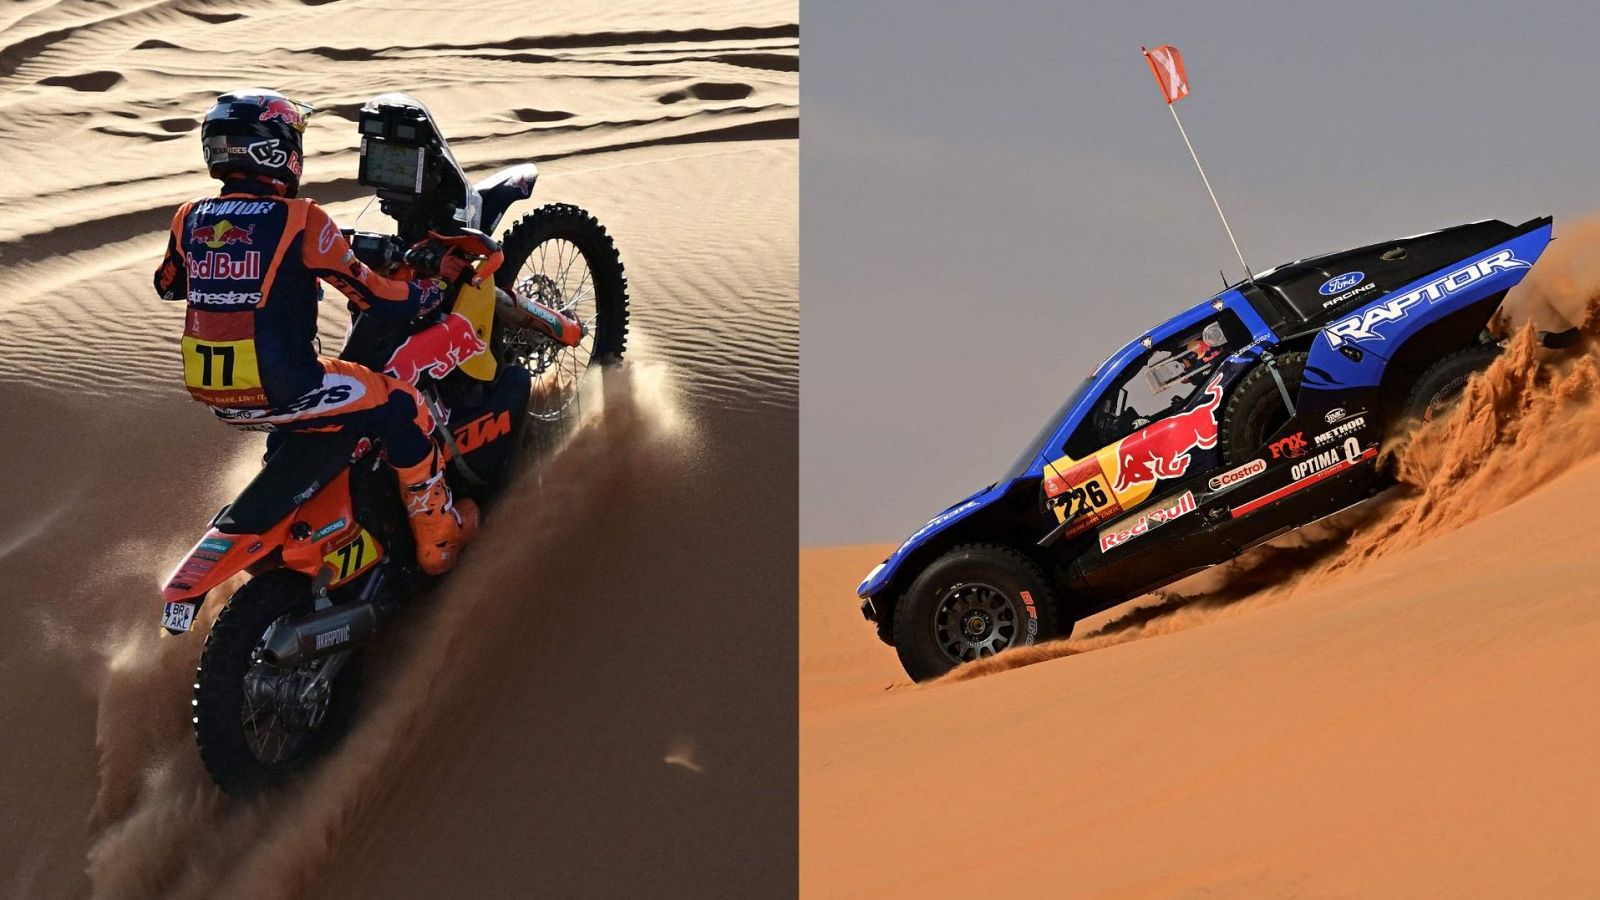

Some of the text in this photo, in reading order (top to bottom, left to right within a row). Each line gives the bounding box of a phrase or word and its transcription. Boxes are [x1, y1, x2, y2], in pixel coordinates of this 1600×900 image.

[213, 251, 260, 280] Bull
[1322, 283, 1376, 308] RACING
[1328, 275, 1357, 292] Ford
[1323, 248, 1532, 351] RAPTOR
[196, 344, 235, 386] 77
[444, 410, 510, 462] KTM
[1314, 417, 1365, 444] METHOD
[1269, 432, 1308, 459] FOX
[1221, 463, 1264, 486] Castrol
[1291, 448, 1340, 481] OPTIMA
[1058, 480, 1108, 520] 226
[1100, 490, 1197, 554] Red Bull
[337, 535, 365, 579] 77
[170, 616, 187, 629] AKL
[172, 604, 185, 615] BR
